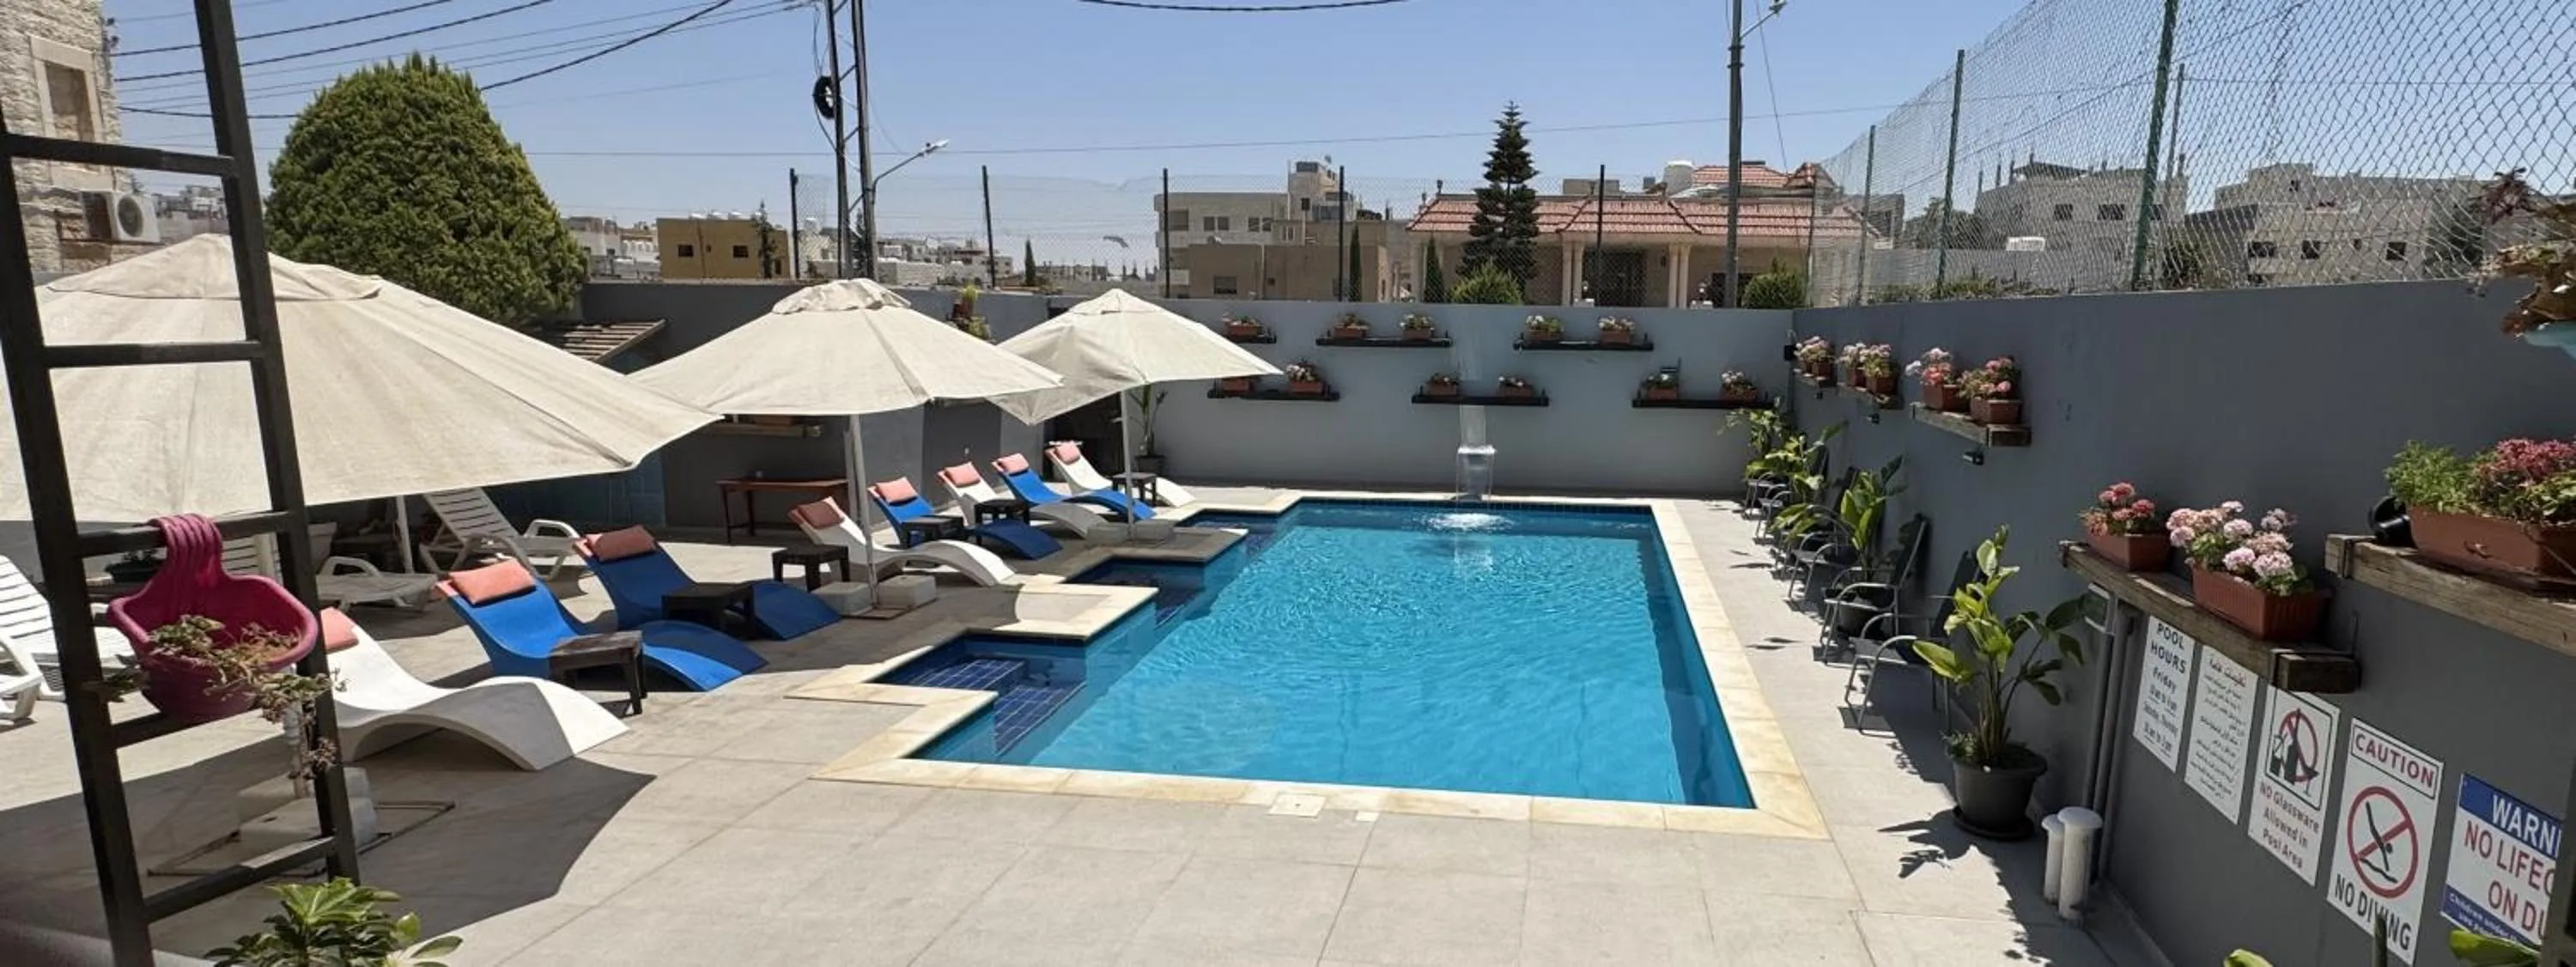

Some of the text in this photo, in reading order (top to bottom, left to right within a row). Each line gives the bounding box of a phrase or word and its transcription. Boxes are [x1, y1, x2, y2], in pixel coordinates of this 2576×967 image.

[2156, 622, 2185, 651] POOL
[2150, 639, 2186, 674] HOURS
[2355, 733, 2434, 788] CAUTION
[2263, 806, 2299, 842] Allowed
[2273, 790, 2319, 834] Glassware
[2263, 828, 2303, 869] Pool Area
[2464, 820, 2492, 859] NO
[2335, 873, 2354, 908] NO
[2488, 880, 2518, 921] ON
